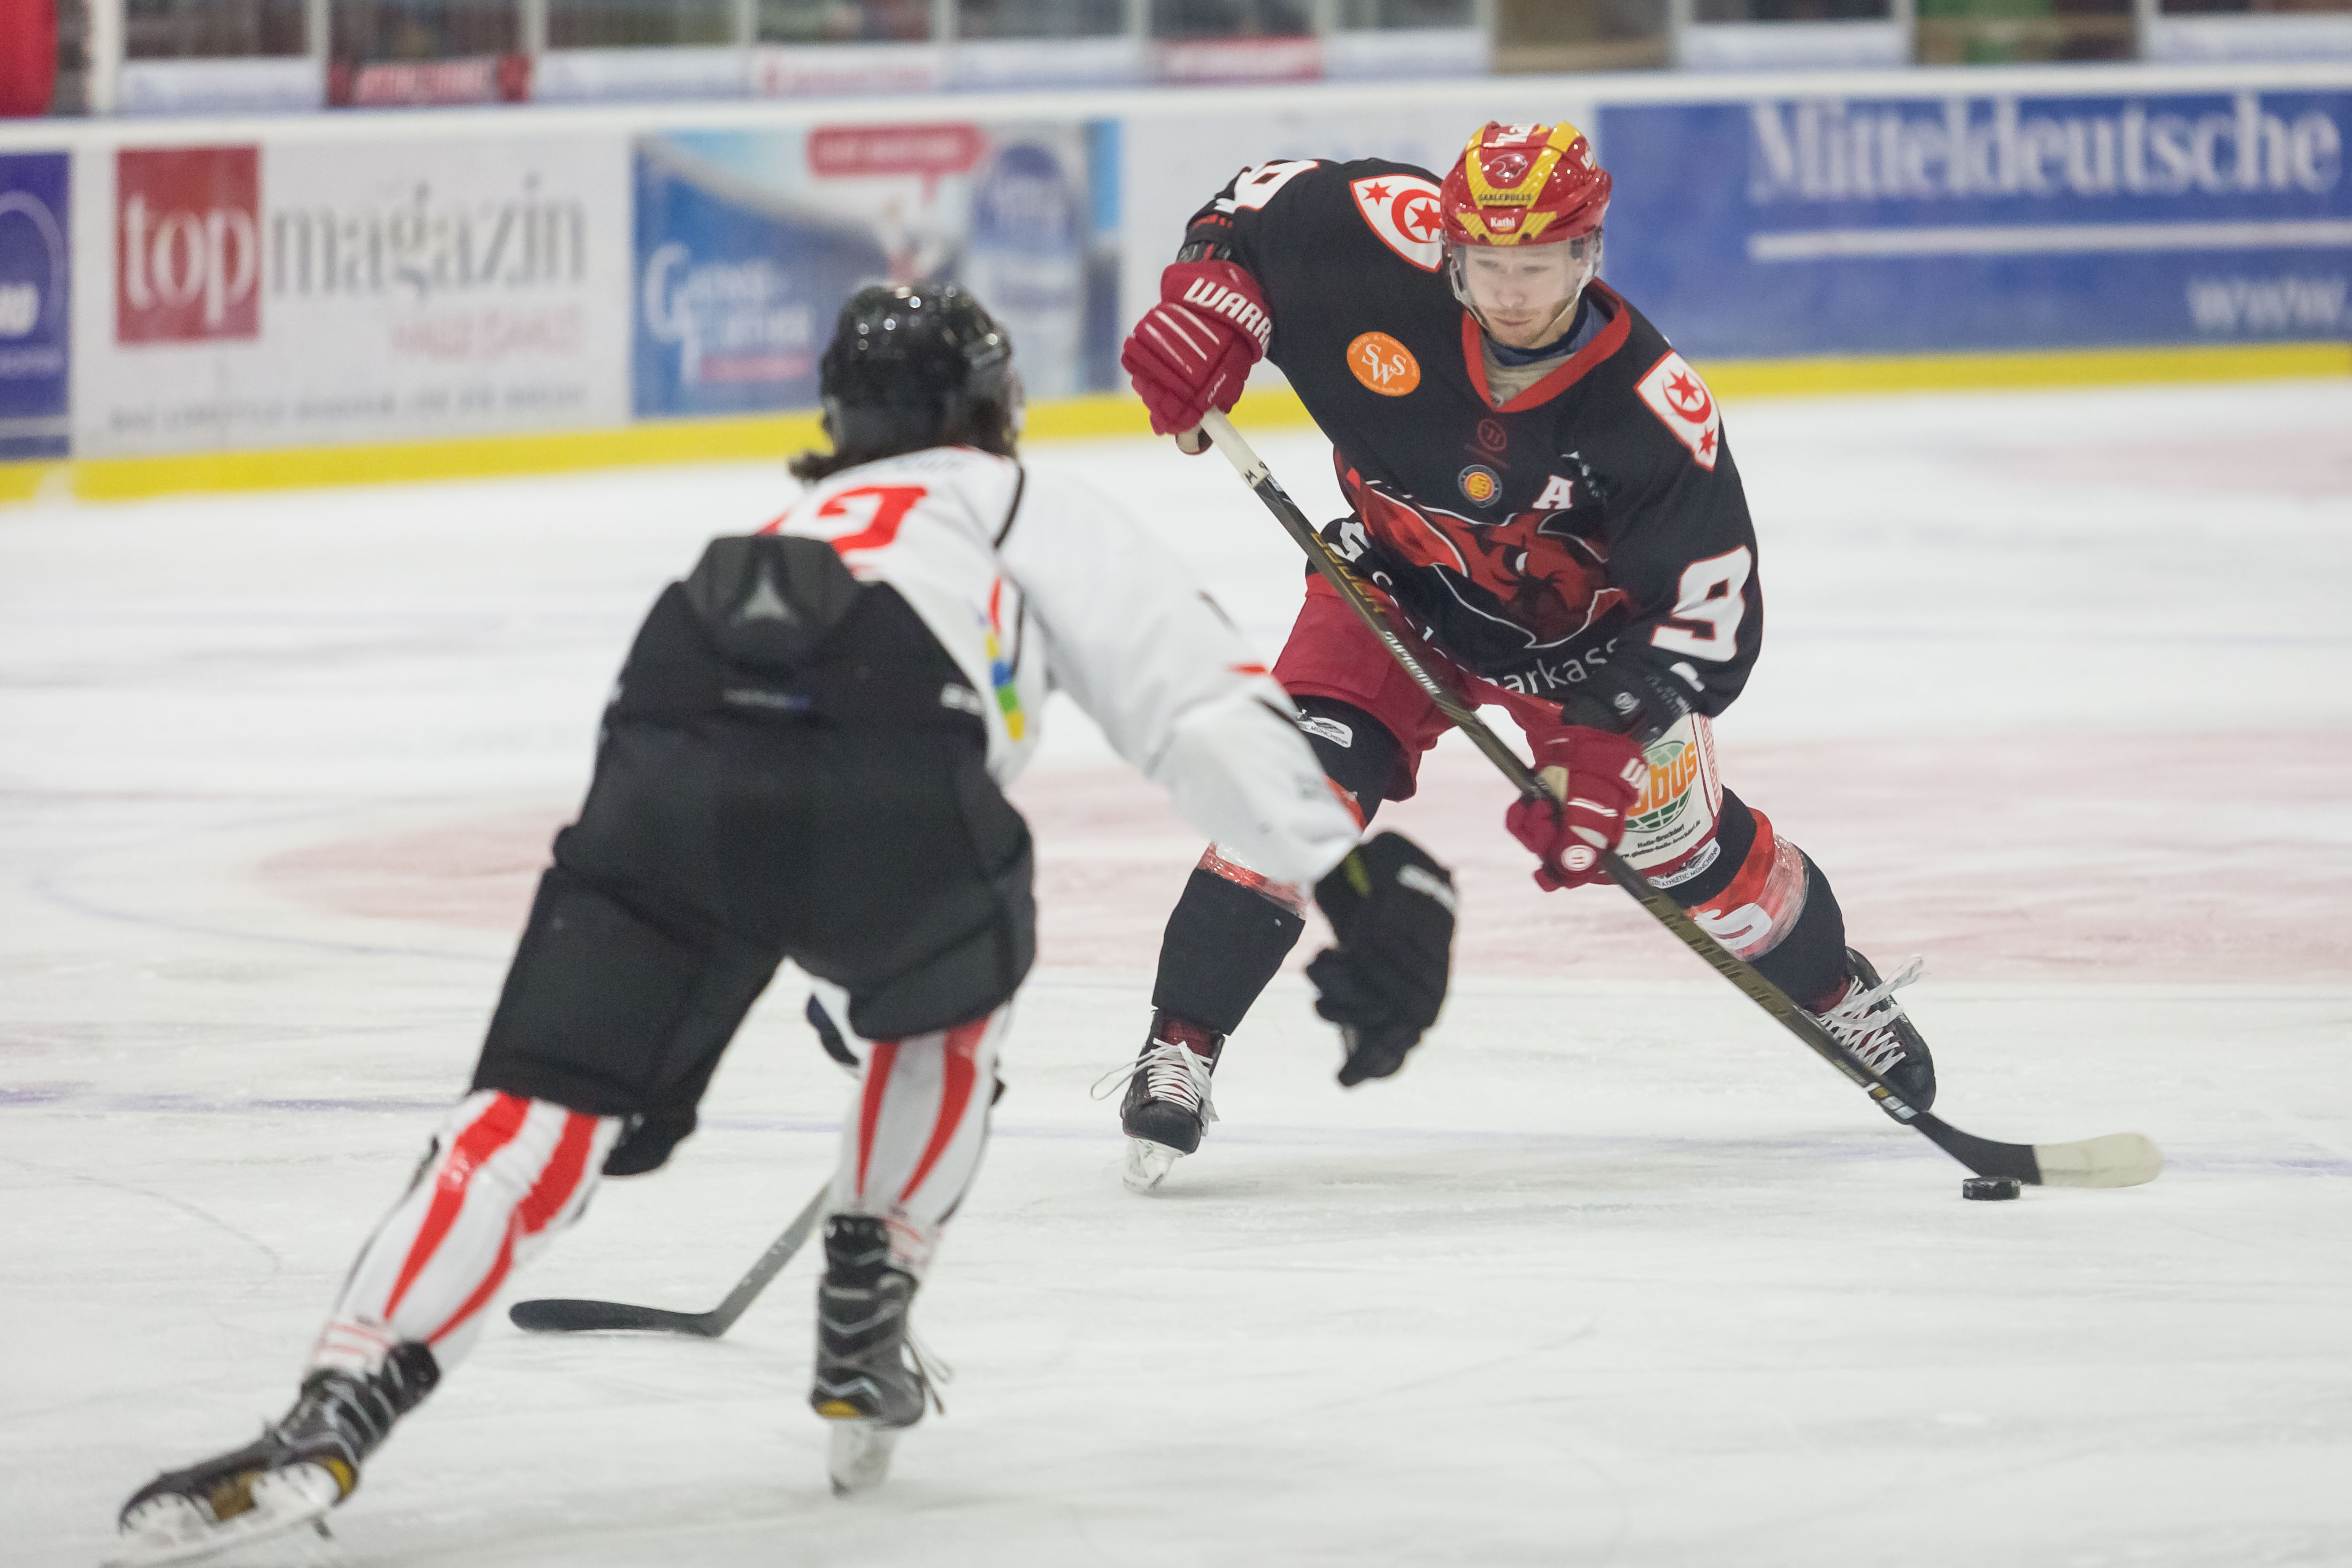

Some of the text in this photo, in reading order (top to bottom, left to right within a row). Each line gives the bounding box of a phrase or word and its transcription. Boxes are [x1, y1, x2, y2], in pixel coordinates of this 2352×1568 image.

[1748, 93, 2341, 202] Mitteldeutsche
[123, 193, 257, 329] top
[271, 171, 586, 304] magazin
[1490, 217, 1515, 227] Kathi
[1532, 474, 1574, 510] A
